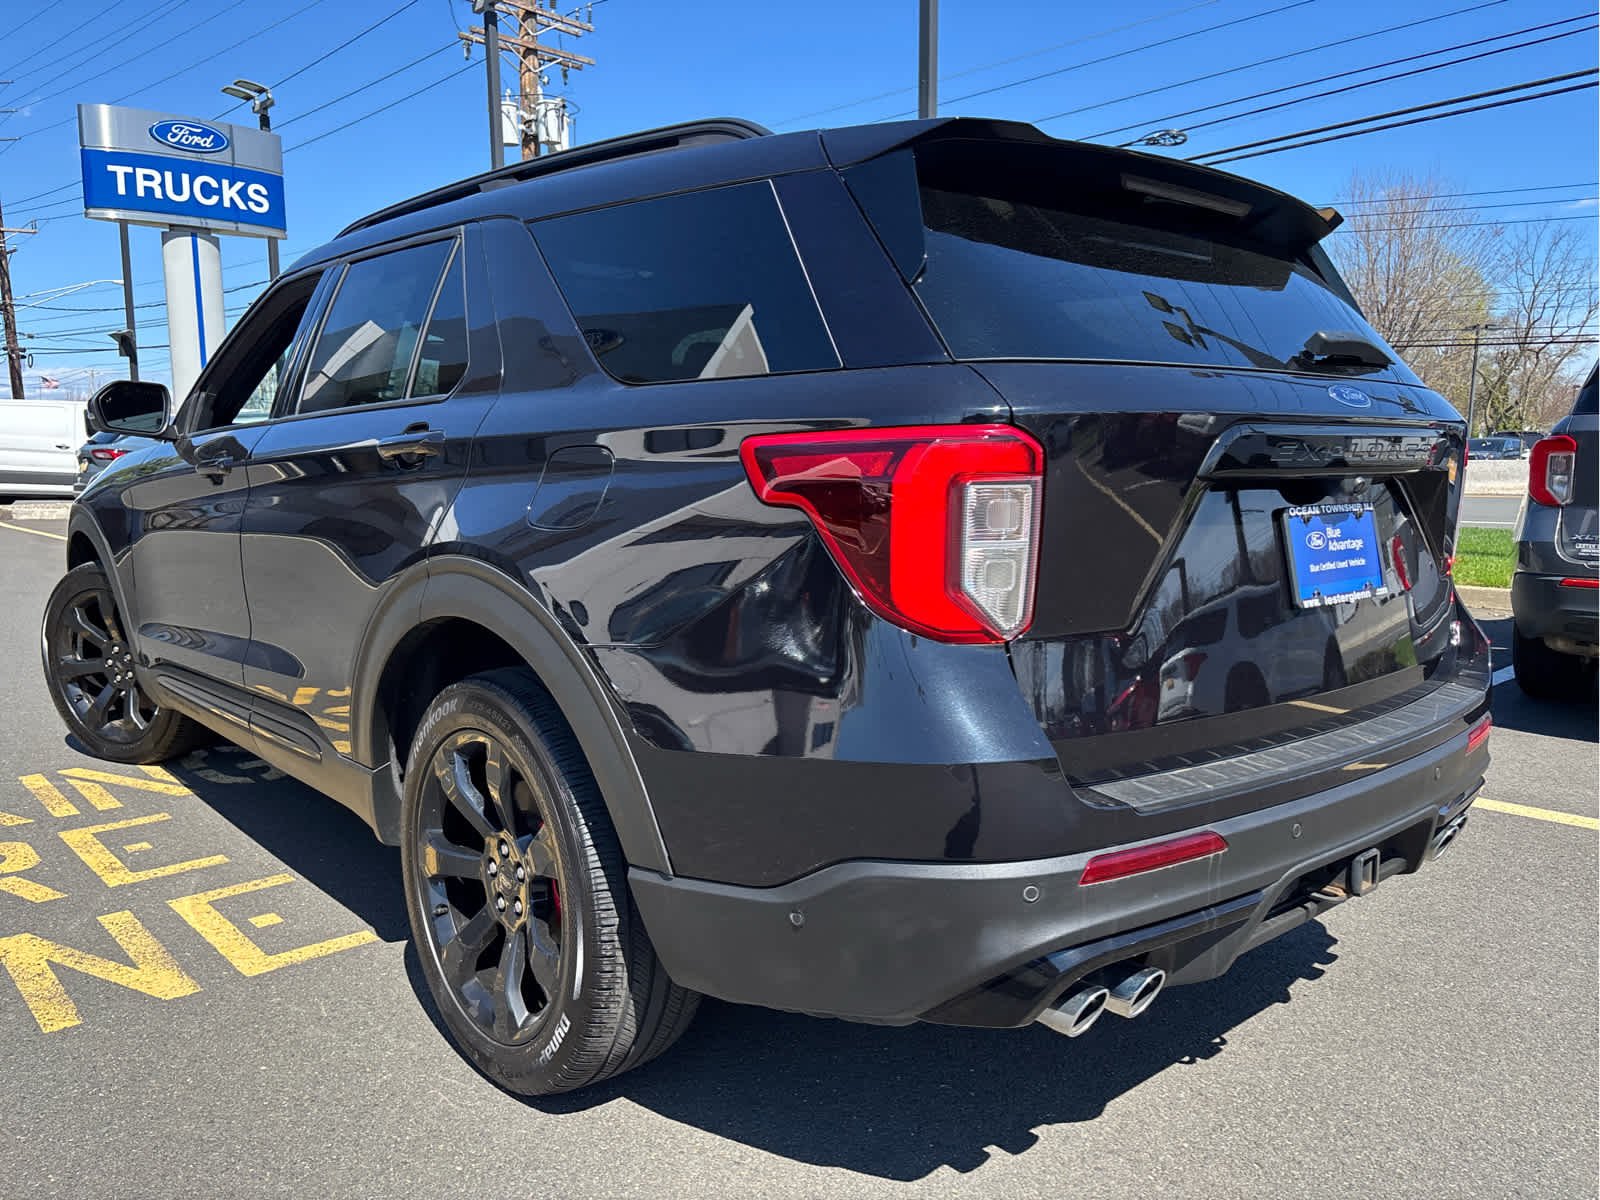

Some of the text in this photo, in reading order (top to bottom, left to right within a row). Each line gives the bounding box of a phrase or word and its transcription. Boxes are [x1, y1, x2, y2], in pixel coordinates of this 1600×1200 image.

[167, 123, 214, 149] Ford
[107, 165, 270, 214] TRUCKS
[1289, 505, 1320, 516] OCEAN
[1326, 527, 1342, 539] Blue
[1328, 538, 1364, 551] Advantage
